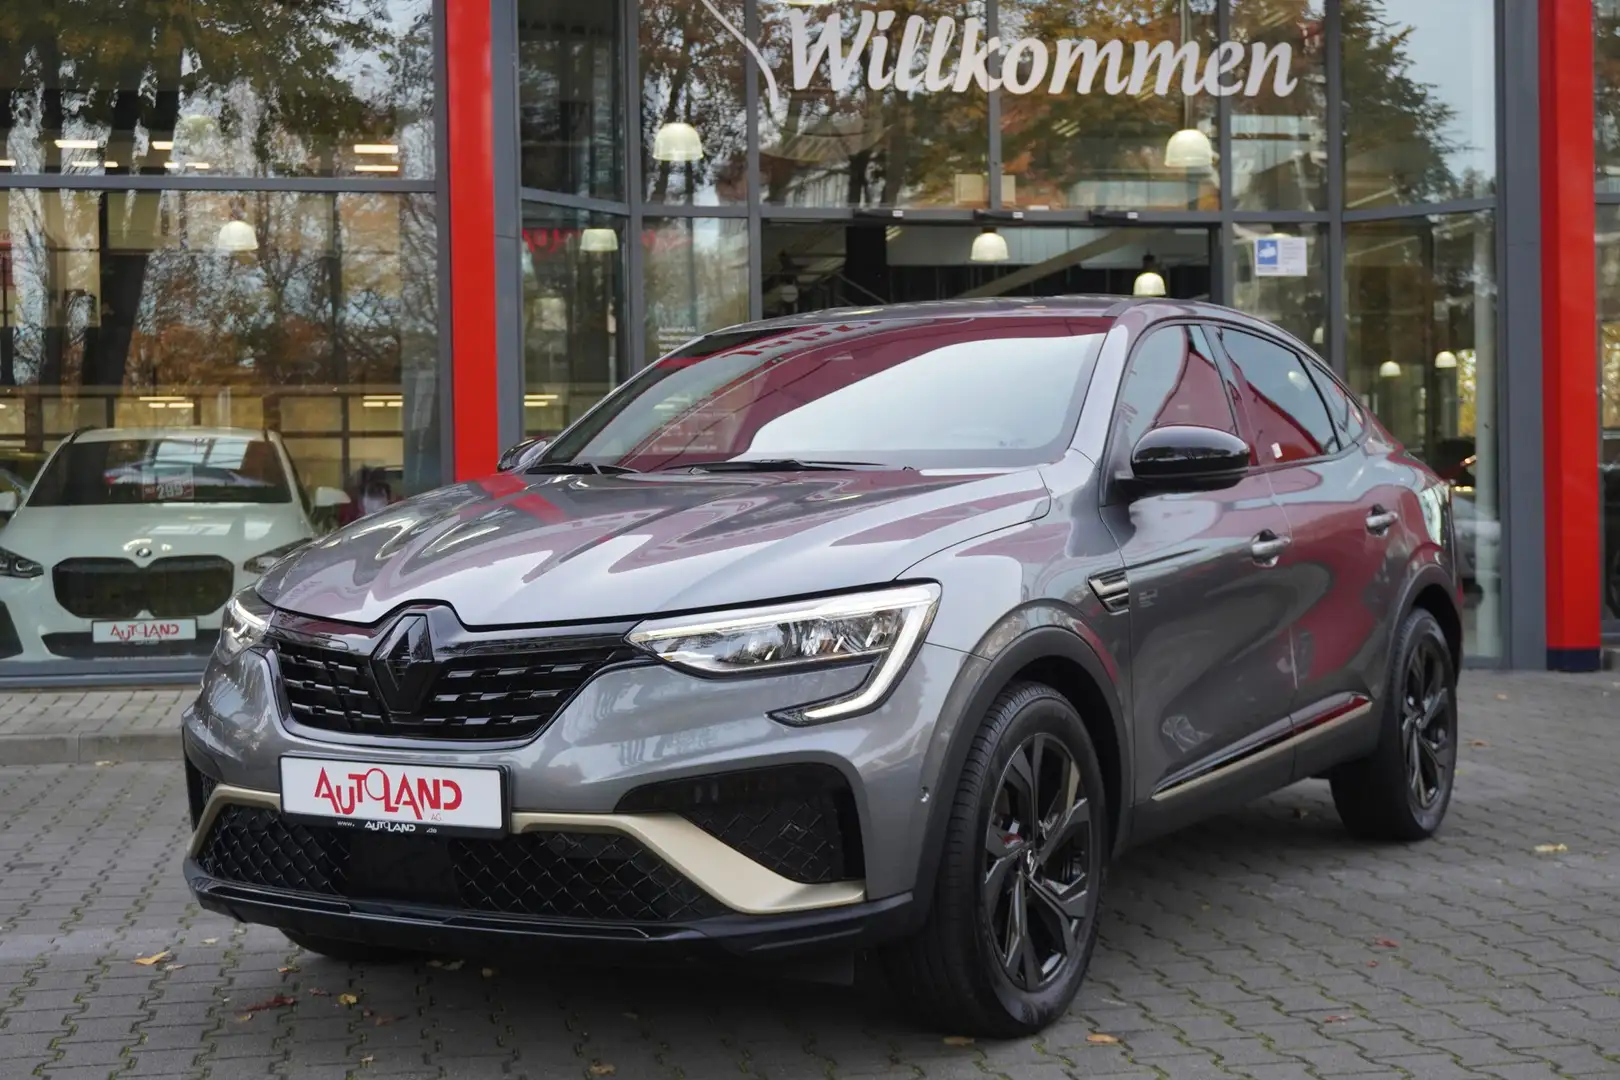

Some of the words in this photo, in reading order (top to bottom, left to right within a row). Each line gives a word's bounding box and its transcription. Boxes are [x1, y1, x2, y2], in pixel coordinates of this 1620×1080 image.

[790, 9, 1298, 97] Willkommen
[110, 622, 179, 641] AUTOLAND
[314, 766, 463, 820] AUTOLAND
[364, 820, 416, 833] AUTOLAND
